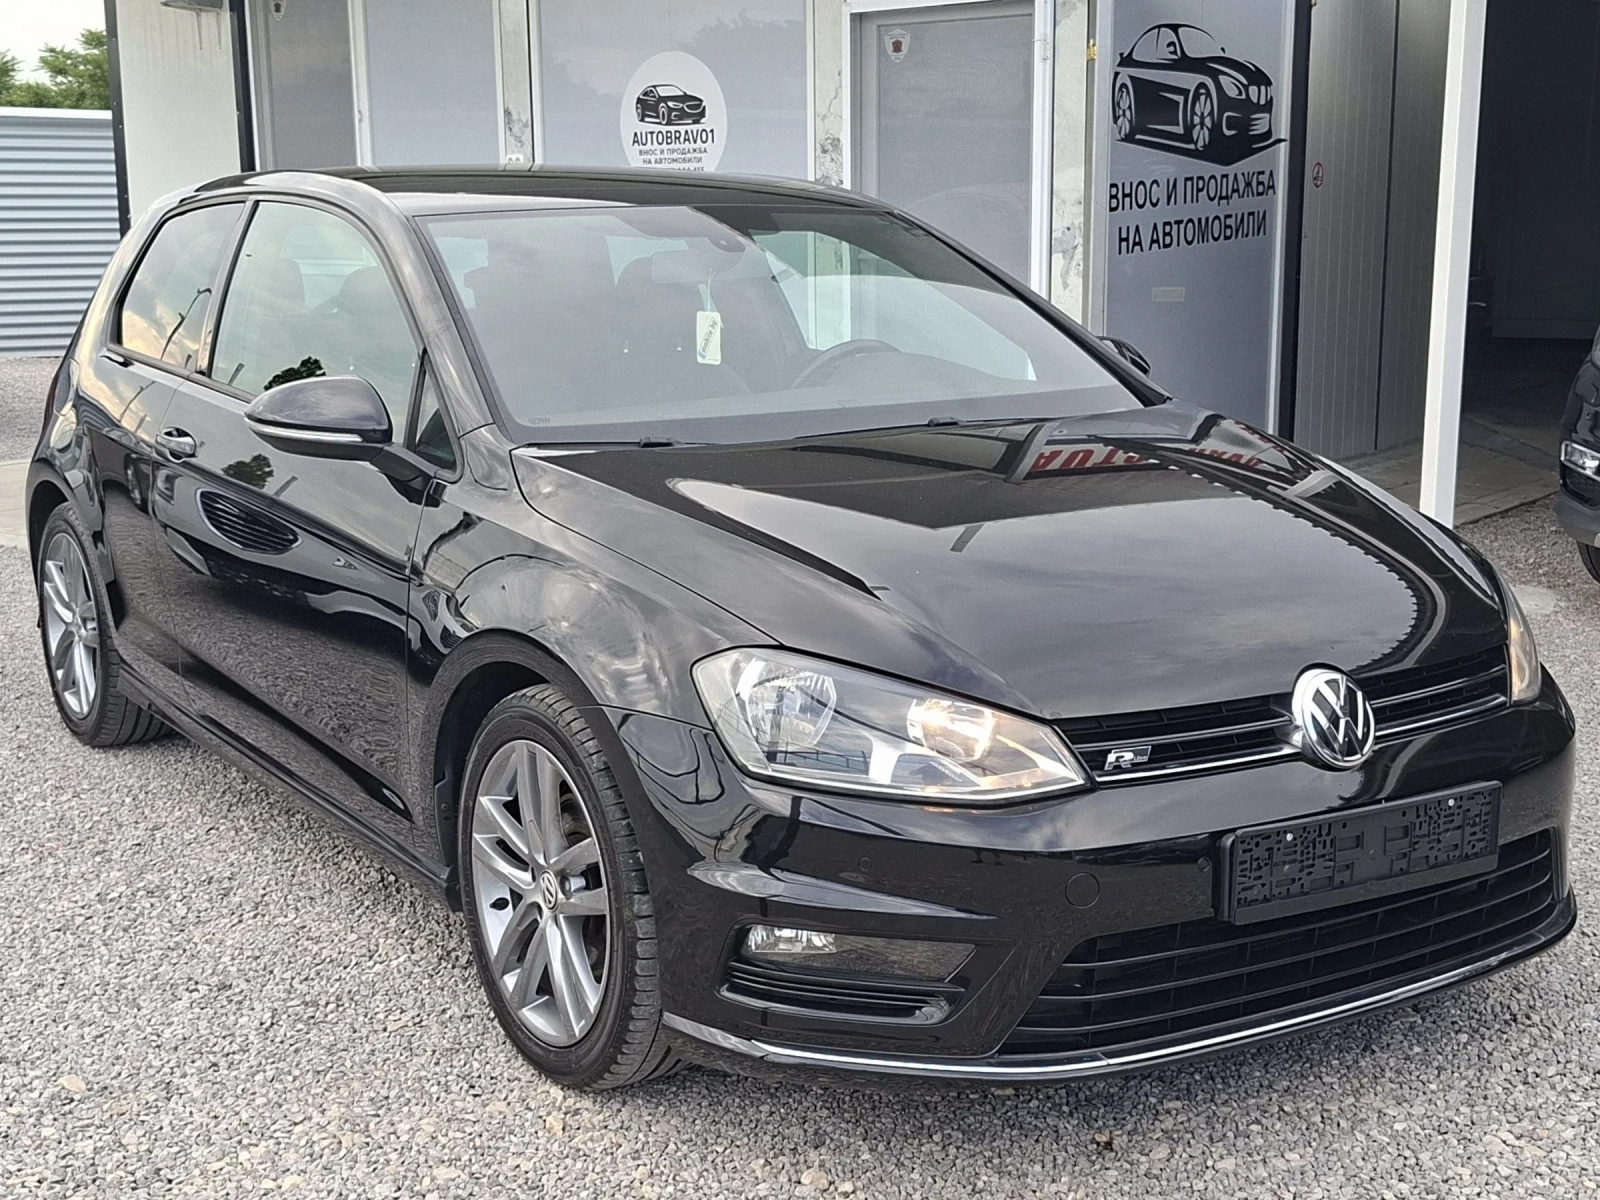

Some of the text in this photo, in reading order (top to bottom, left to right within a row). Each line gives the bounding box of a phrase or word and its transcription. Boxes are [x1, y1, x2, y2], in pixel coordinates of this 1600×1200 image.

[632, 128, 715, 147] AUTOBRAVO1
[653, 156, 703, 165] АВТОМОБИЛИ
[666, 147, 708, 156] ПРОДАЖБА
[1108, 170, 1276, 212] ВНОС И ПРОДАЖБА
[1118, 209, 1267, 255] НА АВТОМОБИЛИ
